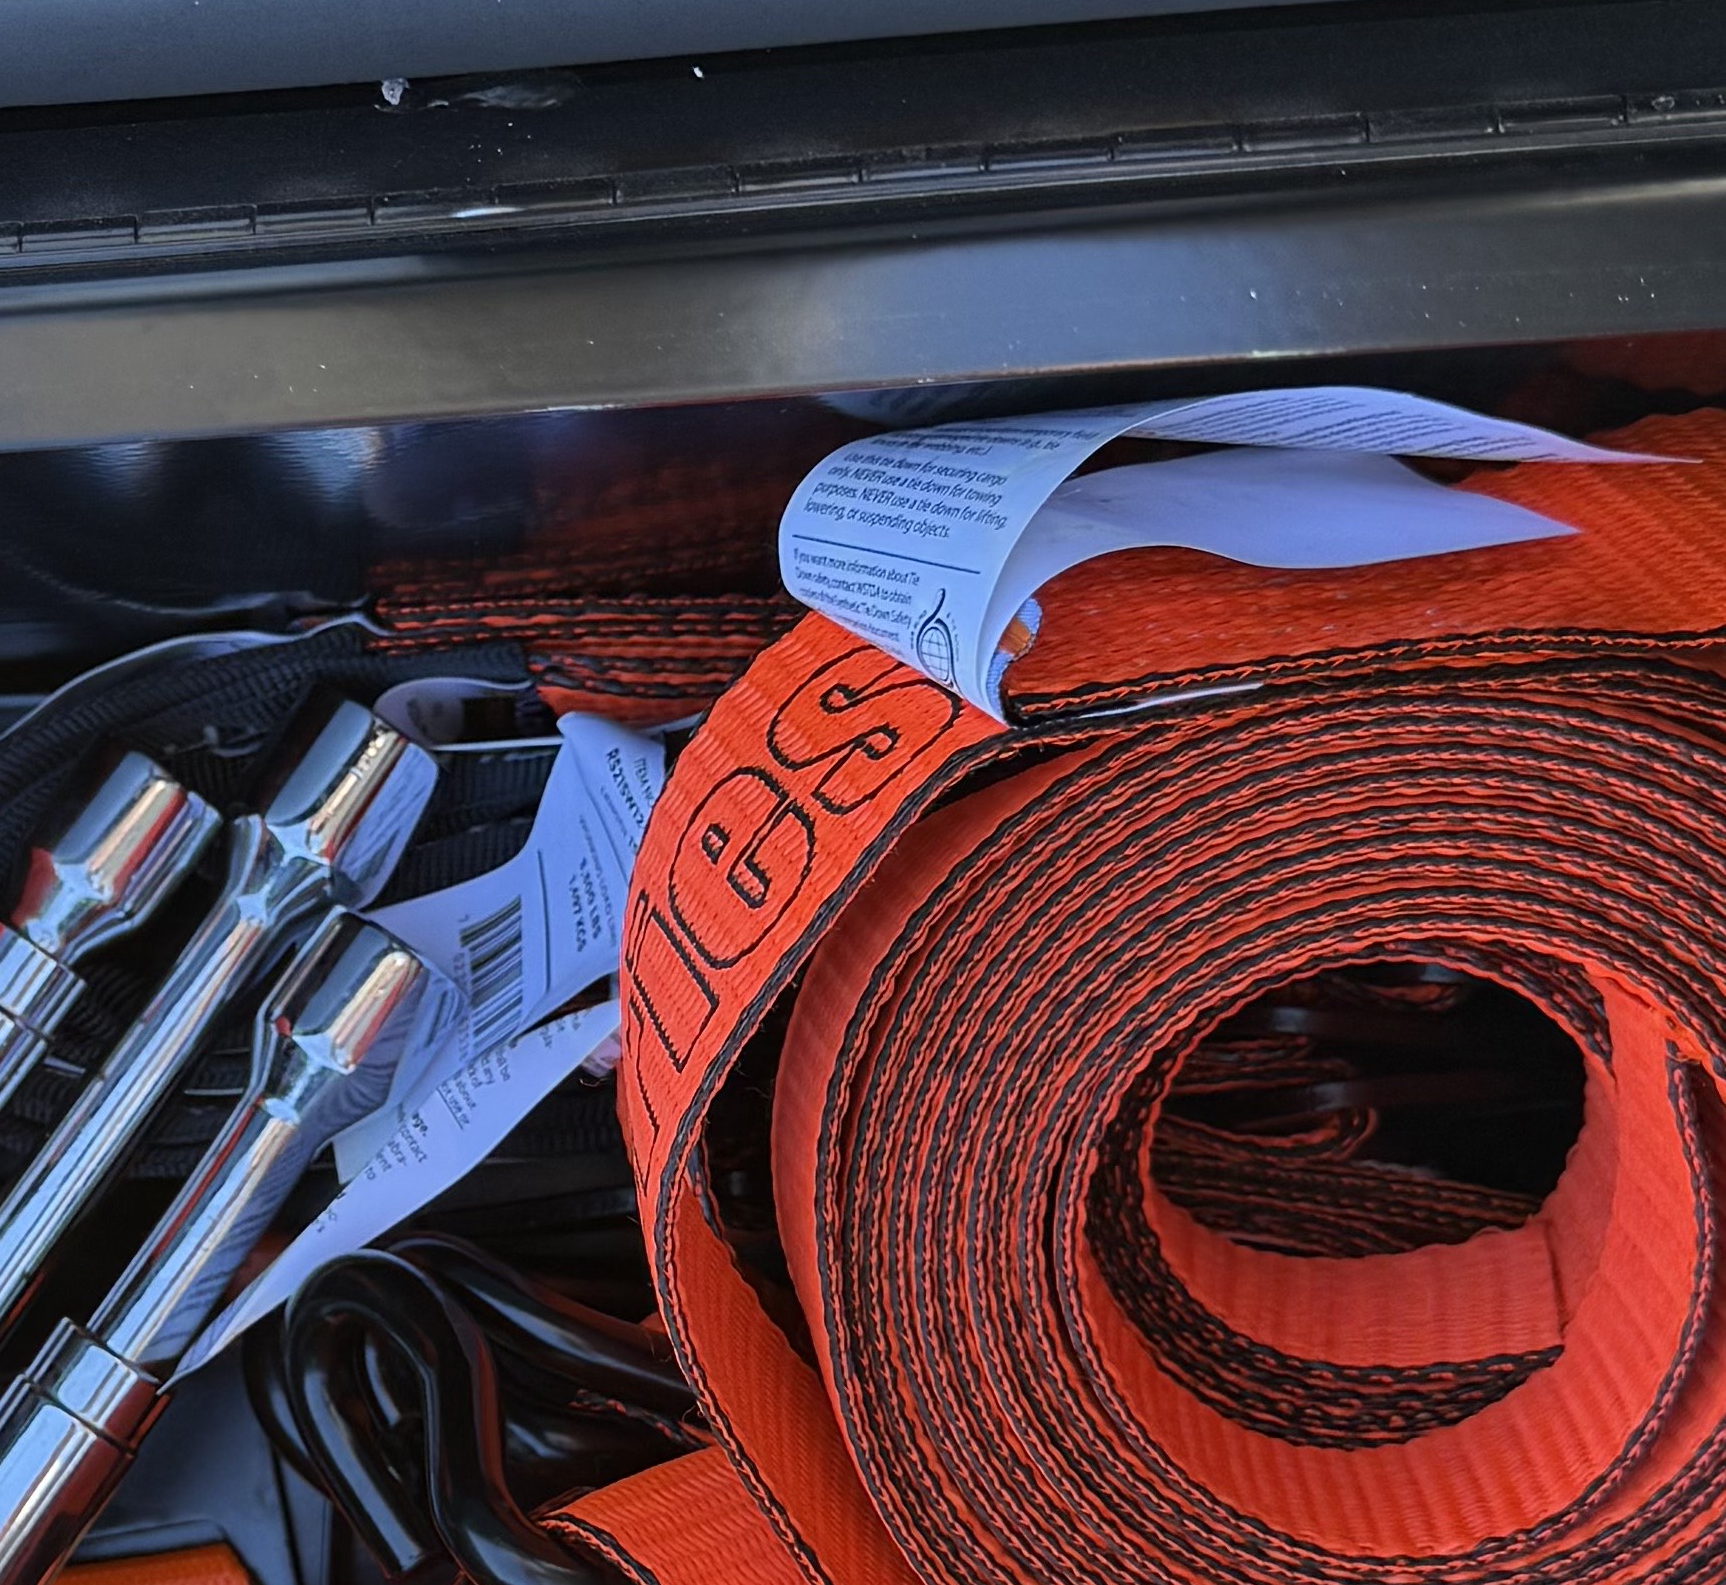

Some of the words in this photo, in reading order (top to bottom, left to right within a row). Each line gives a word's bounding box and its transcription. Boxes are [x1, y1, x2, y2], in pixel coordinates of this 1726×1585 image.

[851, 465, 884, 485] NEVER
[920, 478, 951, 496] down
[949, 482, 967, 499] for
[859, 485, 894, 506] NEVER
[891, 495, 909, 509] use
[917, 499, 932, 513] tie
[930, 499, 960, 518] down
[958, 505, 978, 522] for
[846, 507, 859, 521] or
[857, 507, 914, 535] suspending
[912, 517, 952, 542] objects.
